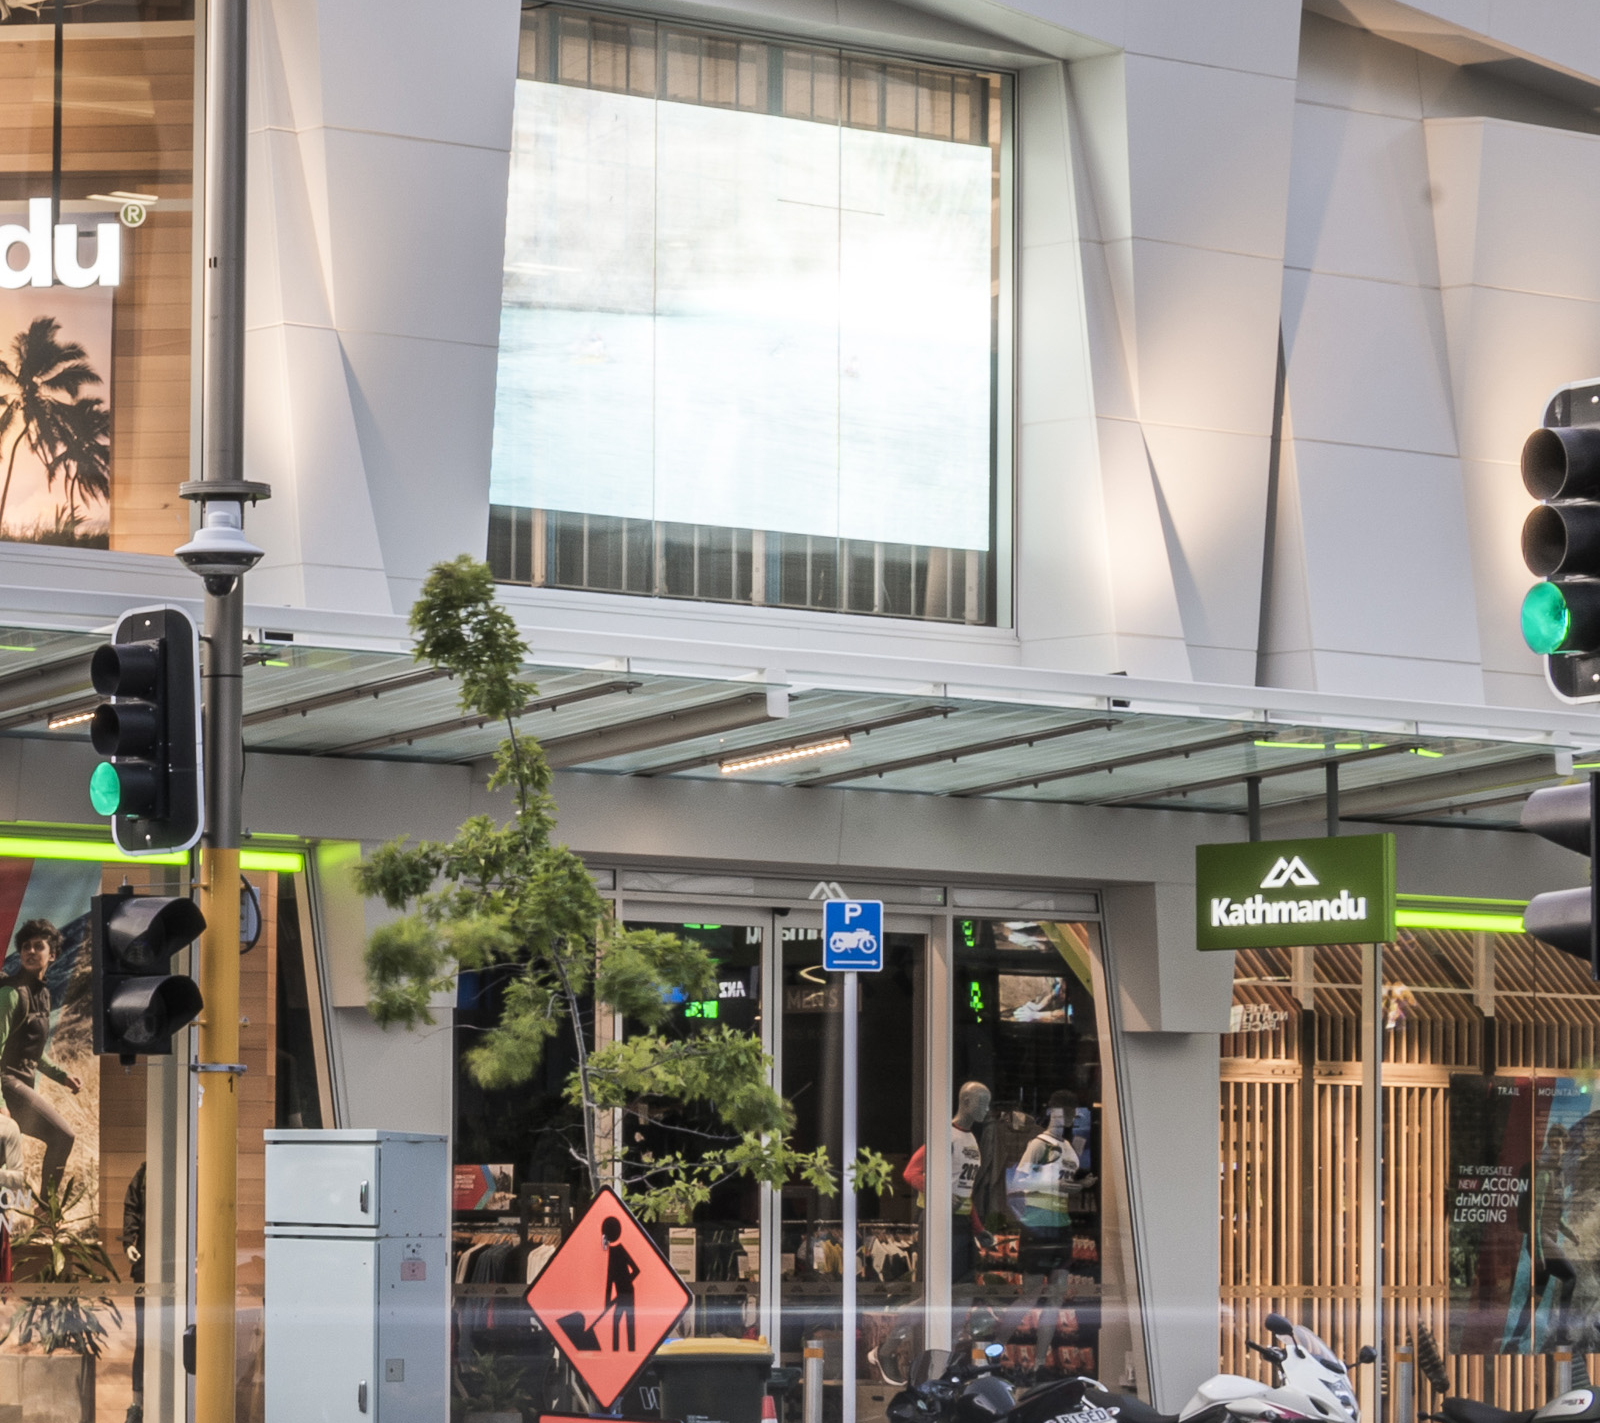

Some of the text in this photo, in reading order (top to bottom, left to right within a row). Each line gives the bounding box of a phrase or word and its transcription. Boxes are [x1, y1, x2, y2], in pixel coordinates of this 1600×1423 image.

[844, 903, 862, 925] P
[1210, 889, 1367, 927] Kathmandu
[1498, 1086, 1520, 1096] TRAIL
[1459, 1165, 1513, 1176] THE VERSATILE
[1458, 1178, 1529, 1192] NEW ACCION
[1456, 1193, 1520, 1207] driMOTION
[1453, 1208, 1507, 1223] LEGGING
